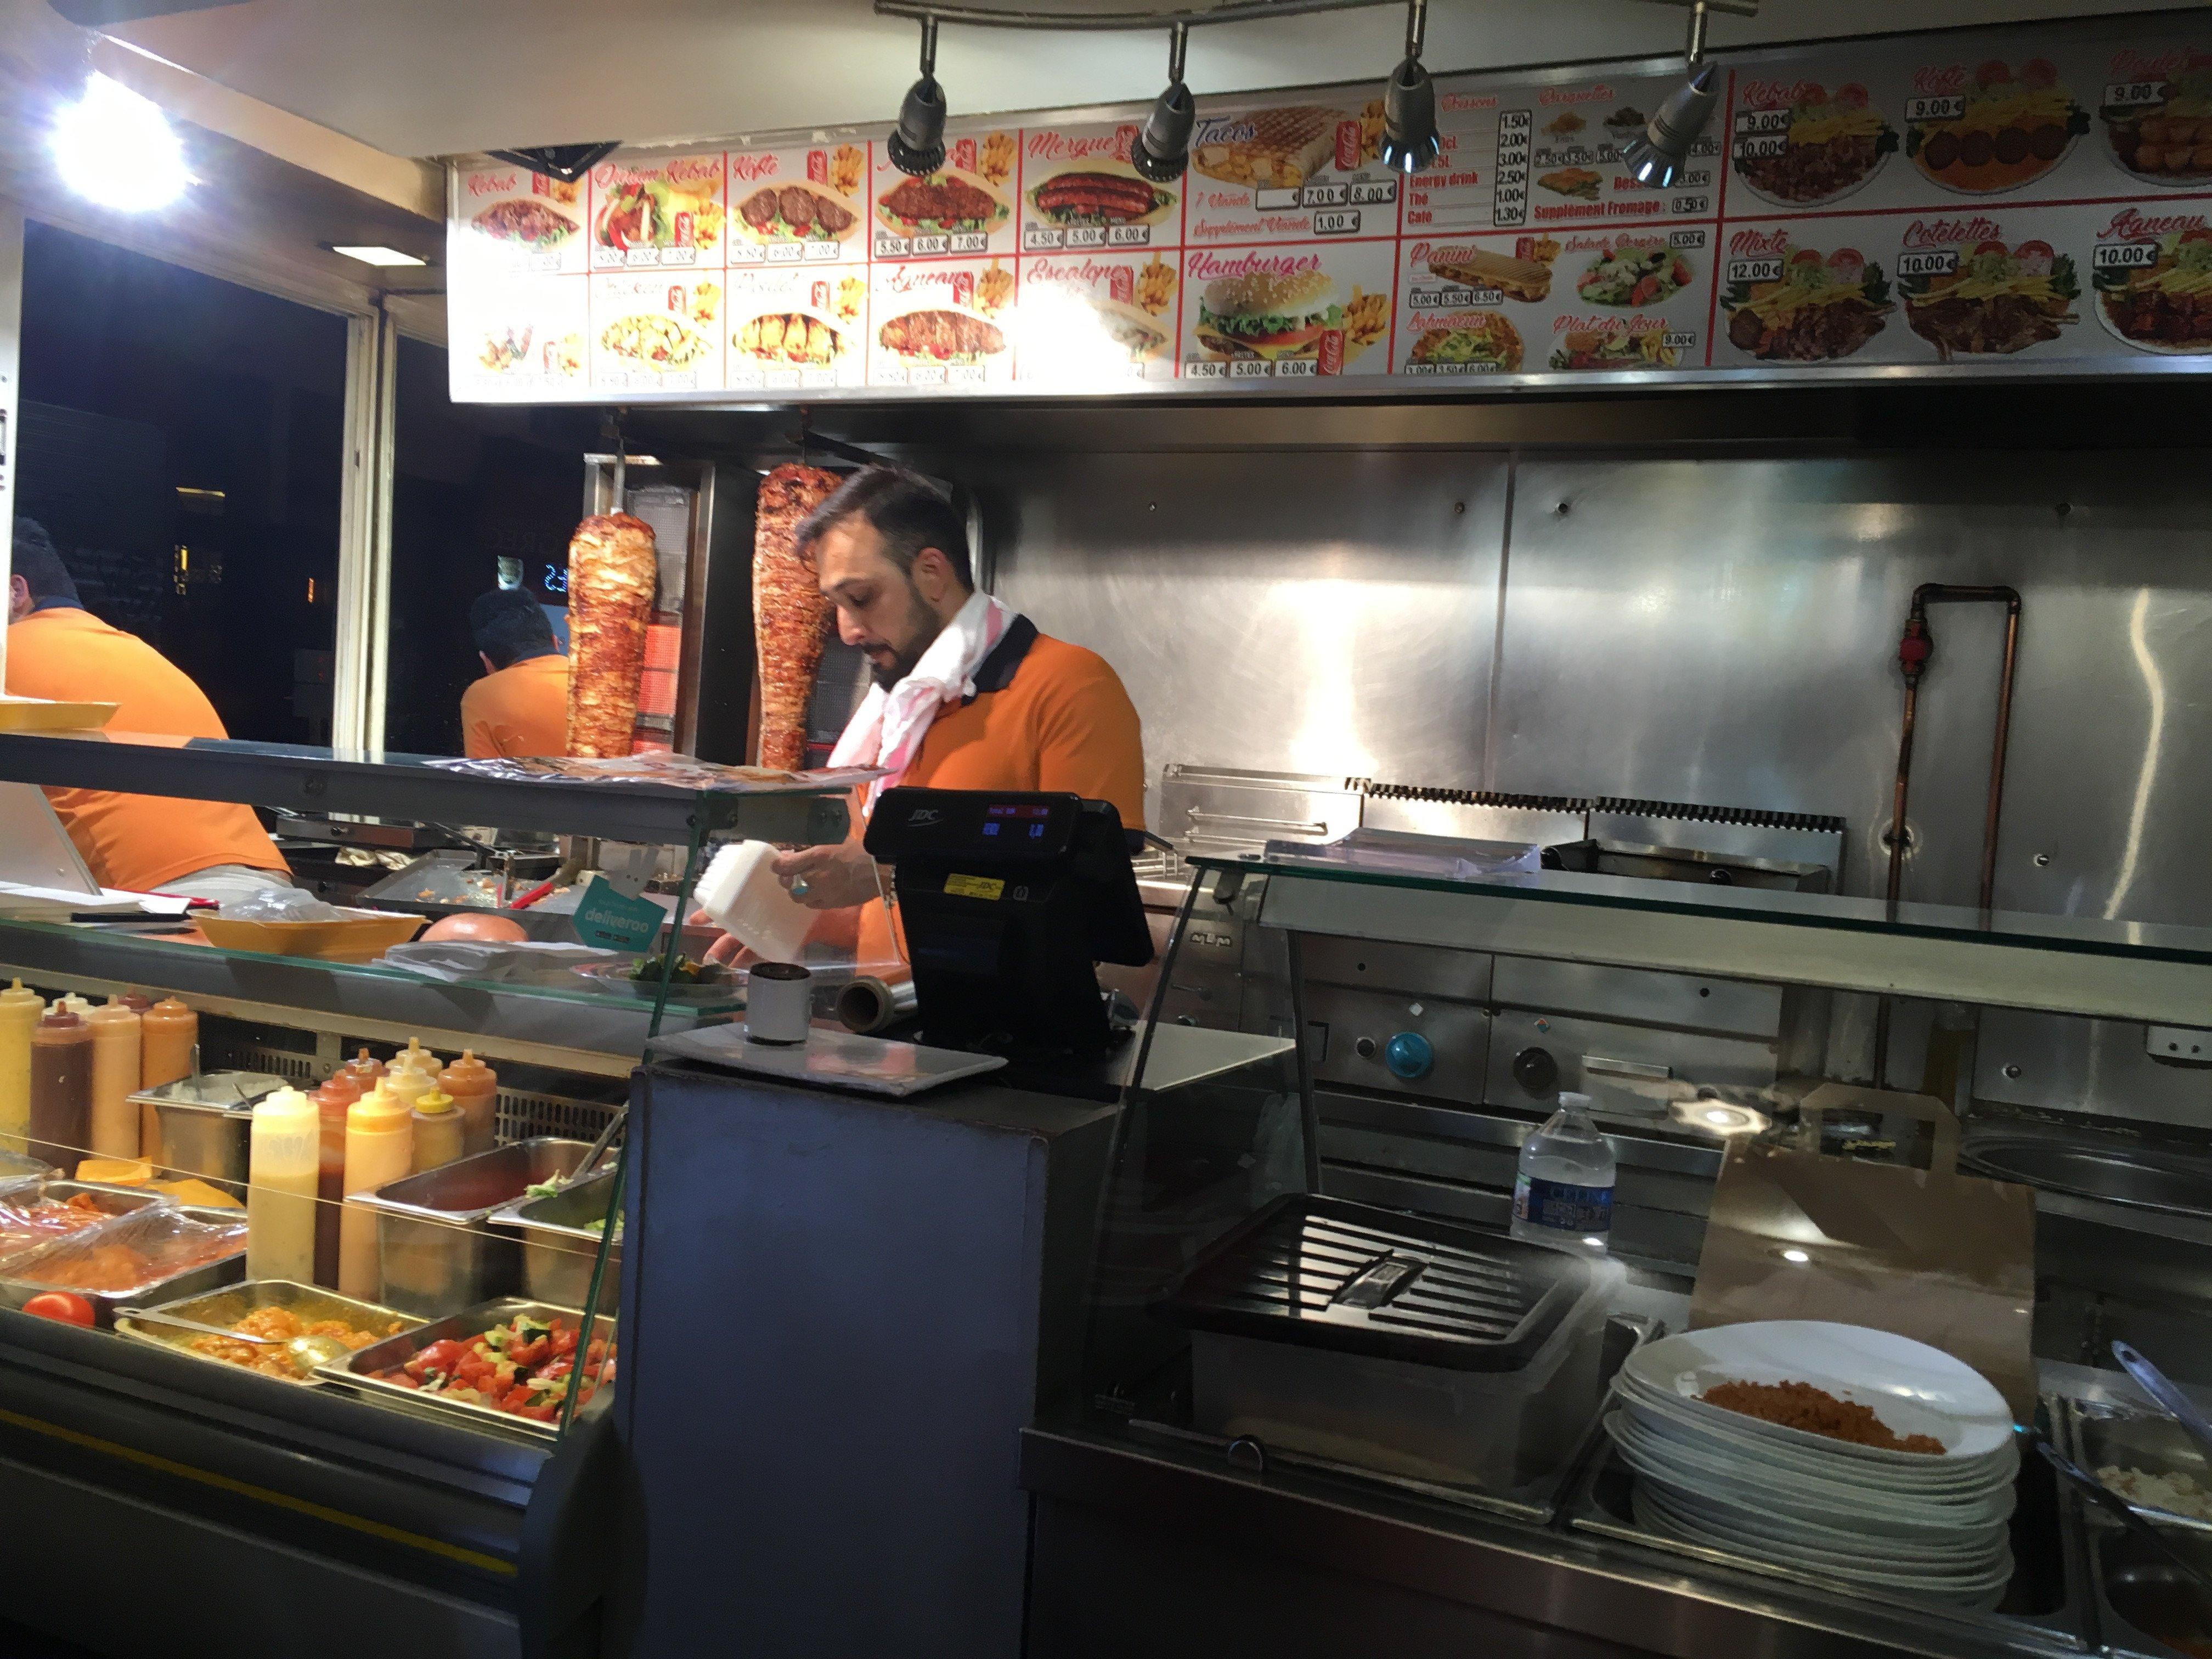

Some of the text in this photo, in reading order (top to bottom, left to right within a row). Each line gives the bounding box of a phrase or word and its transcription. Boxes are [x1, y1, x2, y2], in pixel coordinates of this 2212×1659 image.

[1195, 115, 1257, 146] Tacos
[1409, 176, 1447, 188] Energy
[1448, 171, 1479, 185] drink
[1730, 229, 1790, 257] Mixte
[1187, 250, 1323, 280] Hamburger
[1410, 242, 1477, 267] Panini
[2100, 247, 2143, 264] 10.00
[1282, 362, 1306, 375] 6.00
[908, 808, 939, 822] JDC
